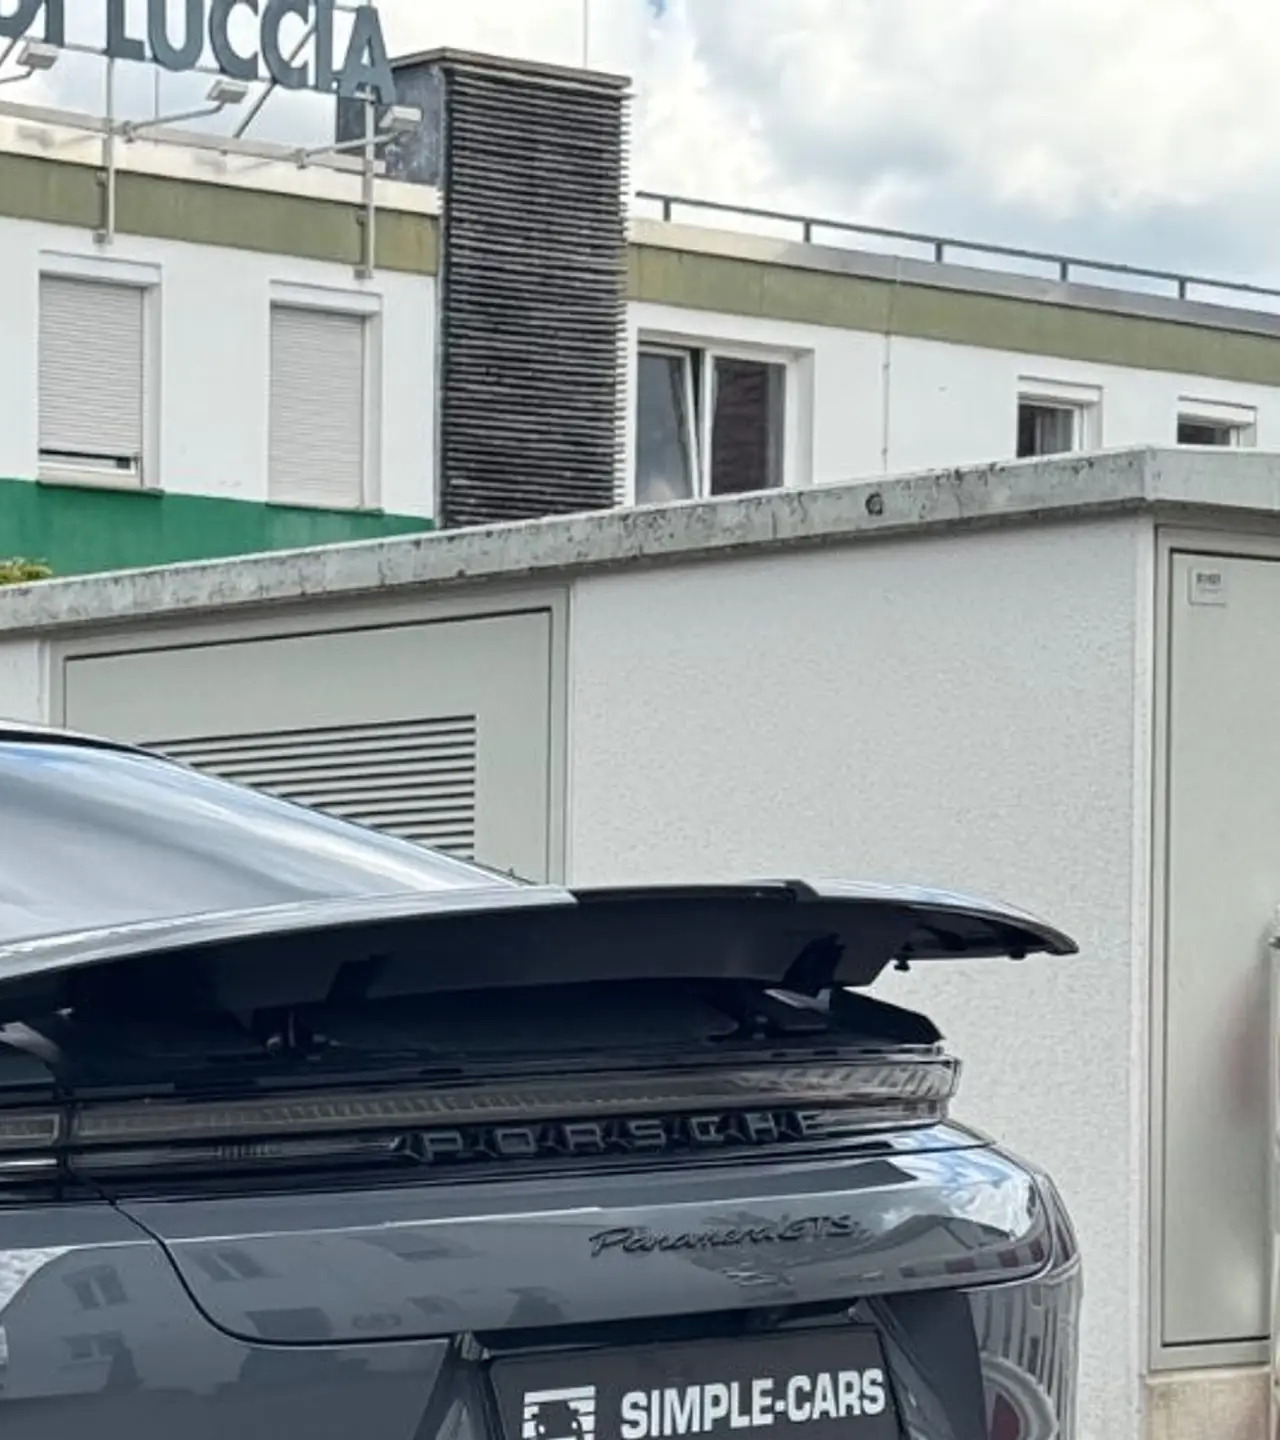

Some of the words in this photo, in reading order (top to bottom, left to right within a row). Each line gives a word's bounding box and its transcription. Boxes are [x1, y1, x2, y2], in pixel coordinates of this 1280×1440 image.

[103, 0, 396, 105] LUCCIA
[421, 1109, 823, 1162] PORSCHE
[619, 1367, 886, 1440] SIMPLE-CARS
